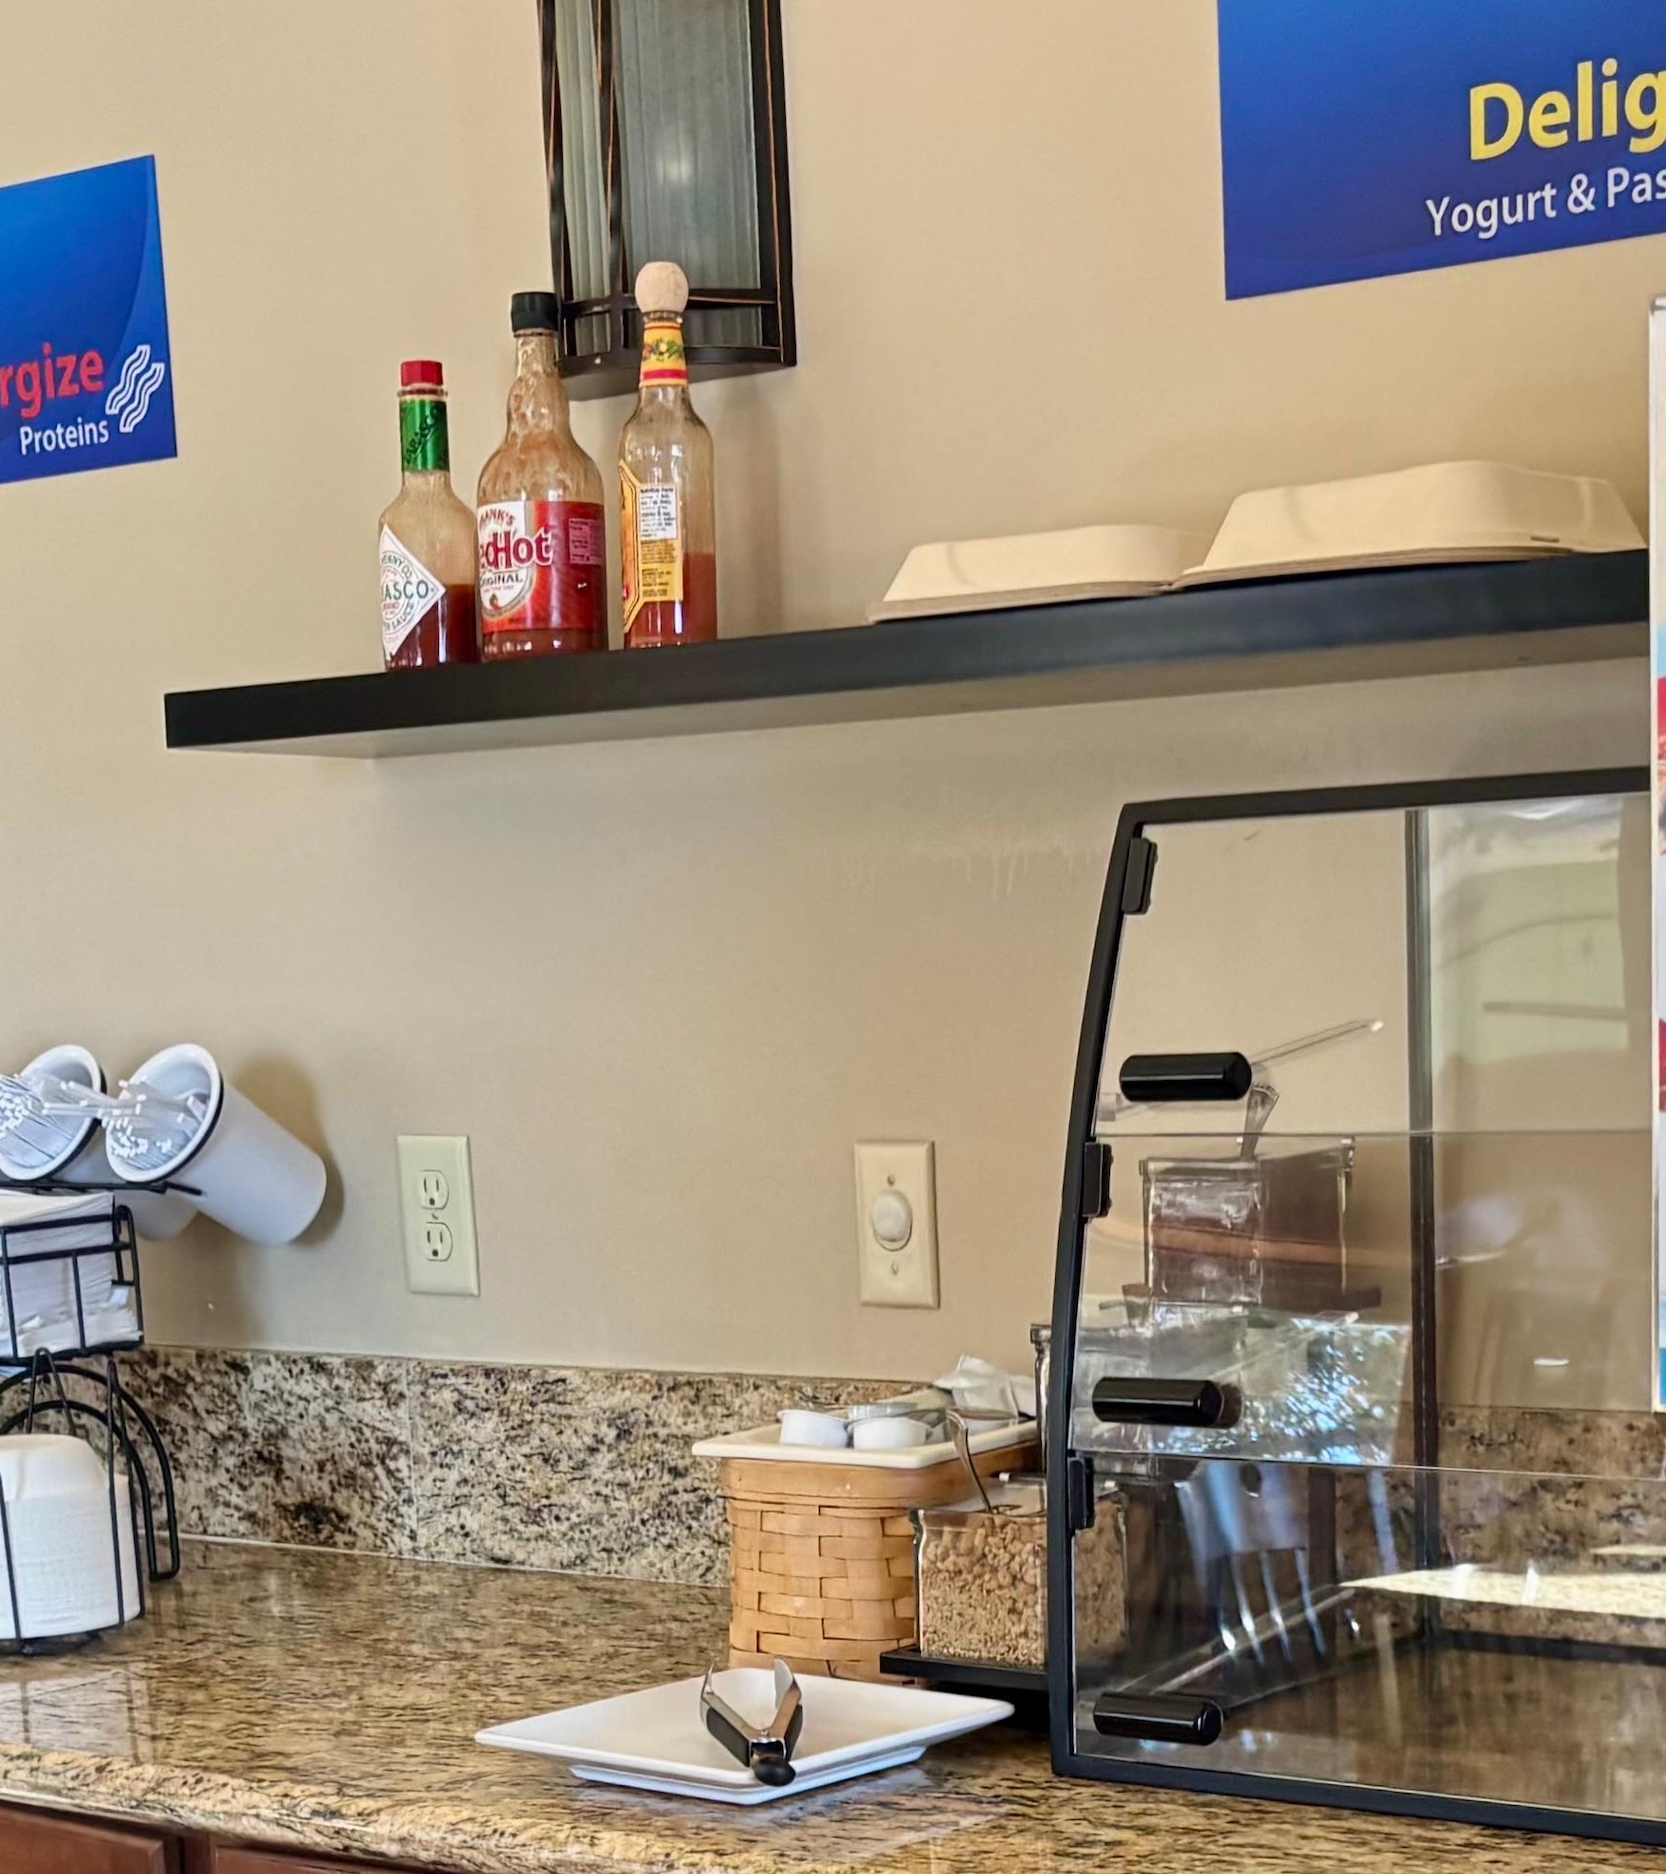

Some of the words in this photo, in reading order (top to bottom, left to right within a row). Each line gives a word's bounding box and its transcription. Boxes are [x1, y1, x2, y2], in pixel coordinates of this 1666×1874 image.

[1426, 182, 1558, 239] Yogurt
[1566, 175, 1597, 214] &
[19, 417, 110, 455] Proteins
